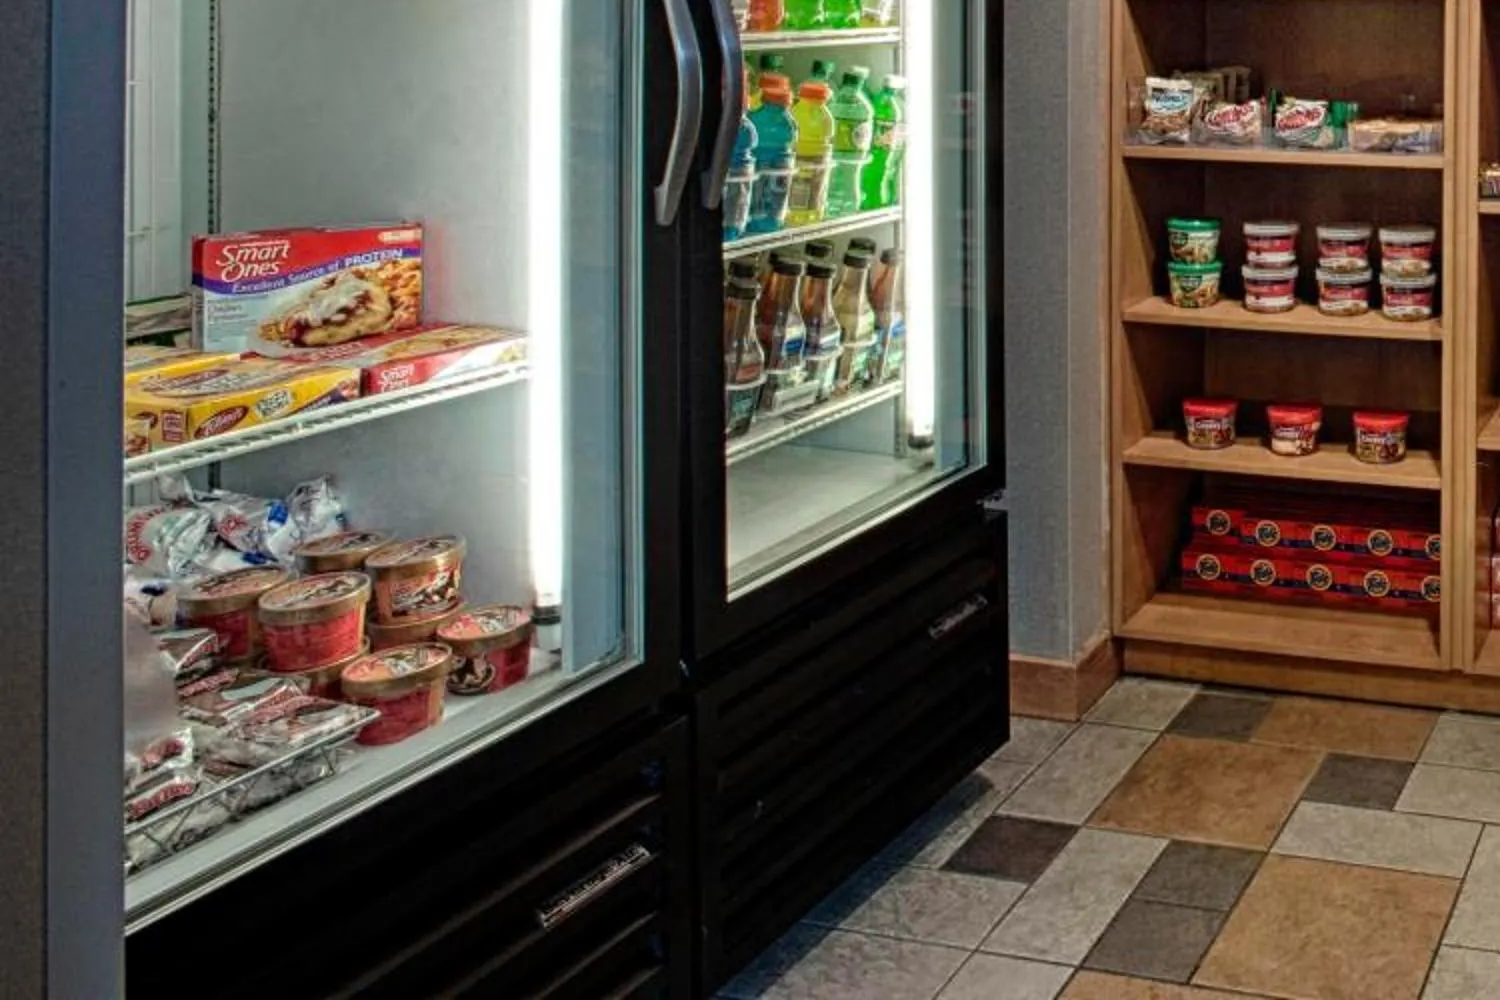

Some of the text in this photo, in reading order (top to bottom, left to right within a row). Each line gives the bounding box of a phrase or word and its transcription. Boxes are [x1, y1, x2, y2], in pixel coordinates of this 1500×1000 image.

[216, 239, 291, 265] Smart
[221, 261, 282, 282] Ones
[232, 277, 285, 293] Excellent
[345, 248, 402, 267] PROTEIN
